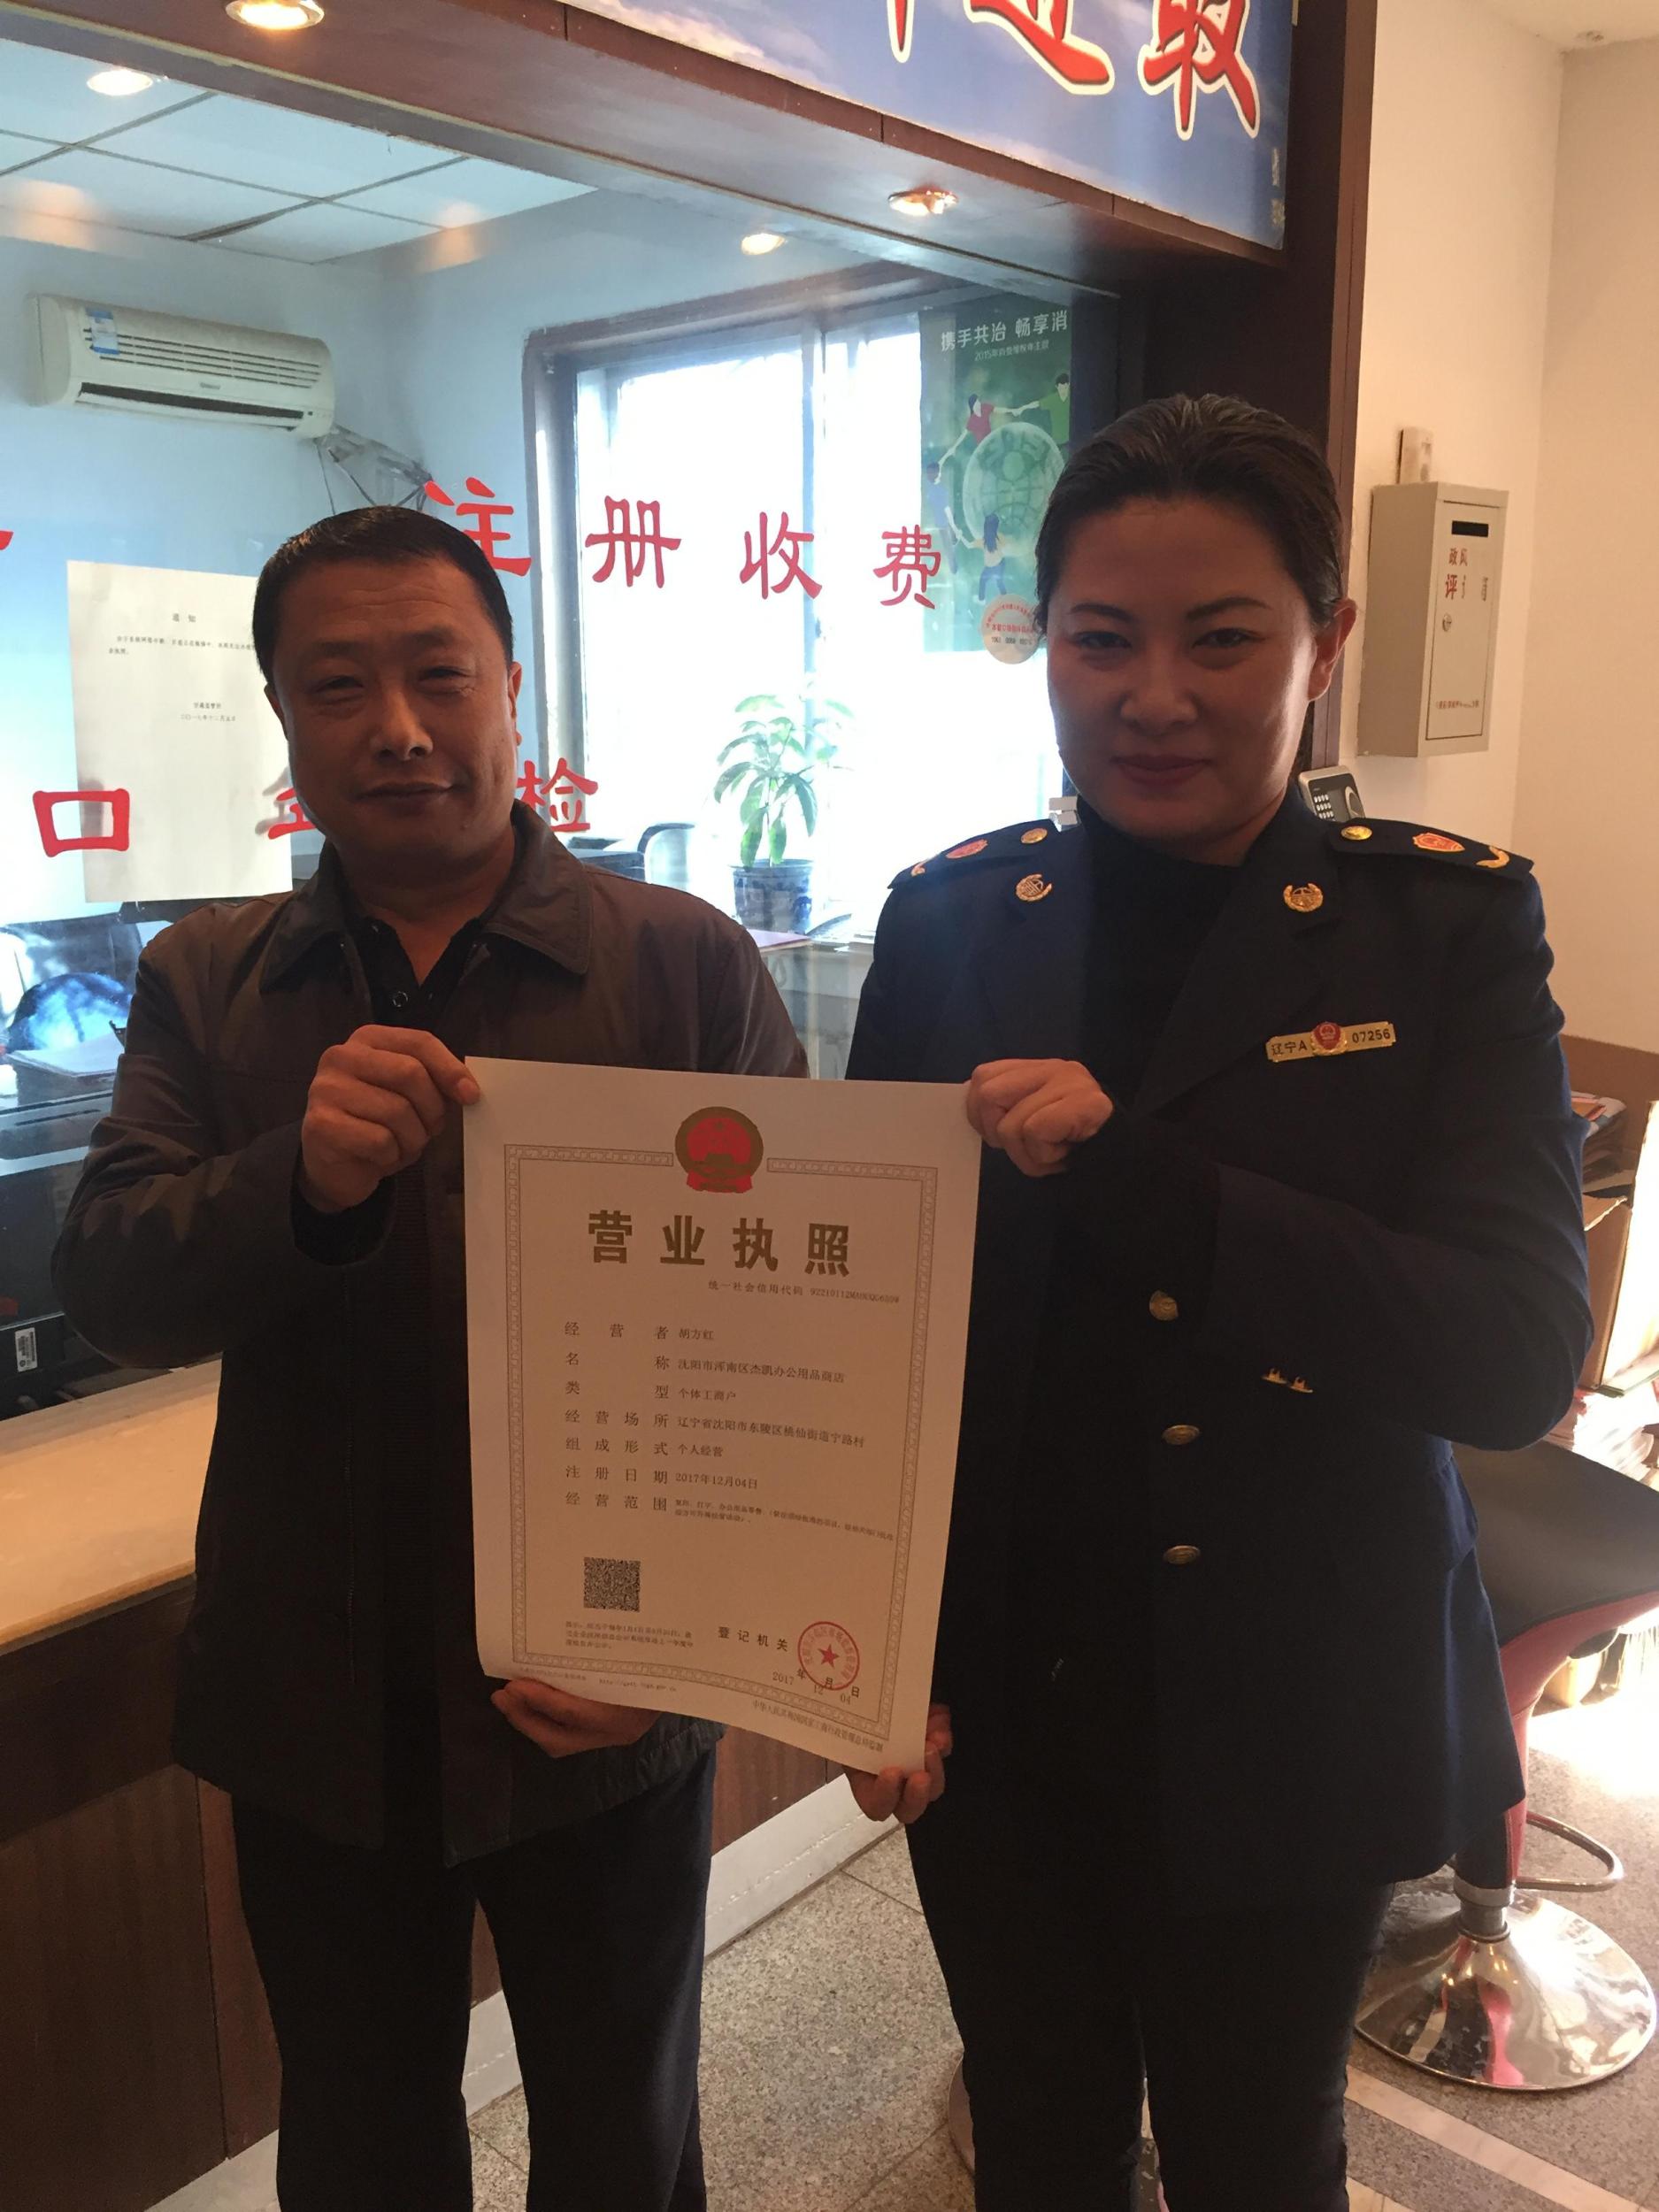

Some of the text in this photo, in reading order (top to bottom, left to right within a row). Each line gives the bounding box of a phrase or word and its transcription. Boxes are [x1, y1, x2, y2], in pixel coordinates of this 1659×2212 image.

[941, 310, 1068, 352] 携手共治 畅享消
[1271, 1028, 1392, 1056] 辽宁A 07256
[588, 1210, 850, 1278] 营业执照
[708, 1280, 803, 1297] 统一社会信用代码
[565, 1321, 715, 1340] 经营者 胡方红
[565, 1351, 671, 1371] 名称
[565, 1380, 736, 1402] 类型 个体工商户
[565, 1409, 668, 1428] 经营场所
[565, 1437, 724, 1458] 组成形式 个人经营
[565, 1464, 758, 1490] 注册日期 2017年12月04日
[565, 1491, 667, 1512] 经营范围
[718, 1625, 789, 1653] 登记机关
